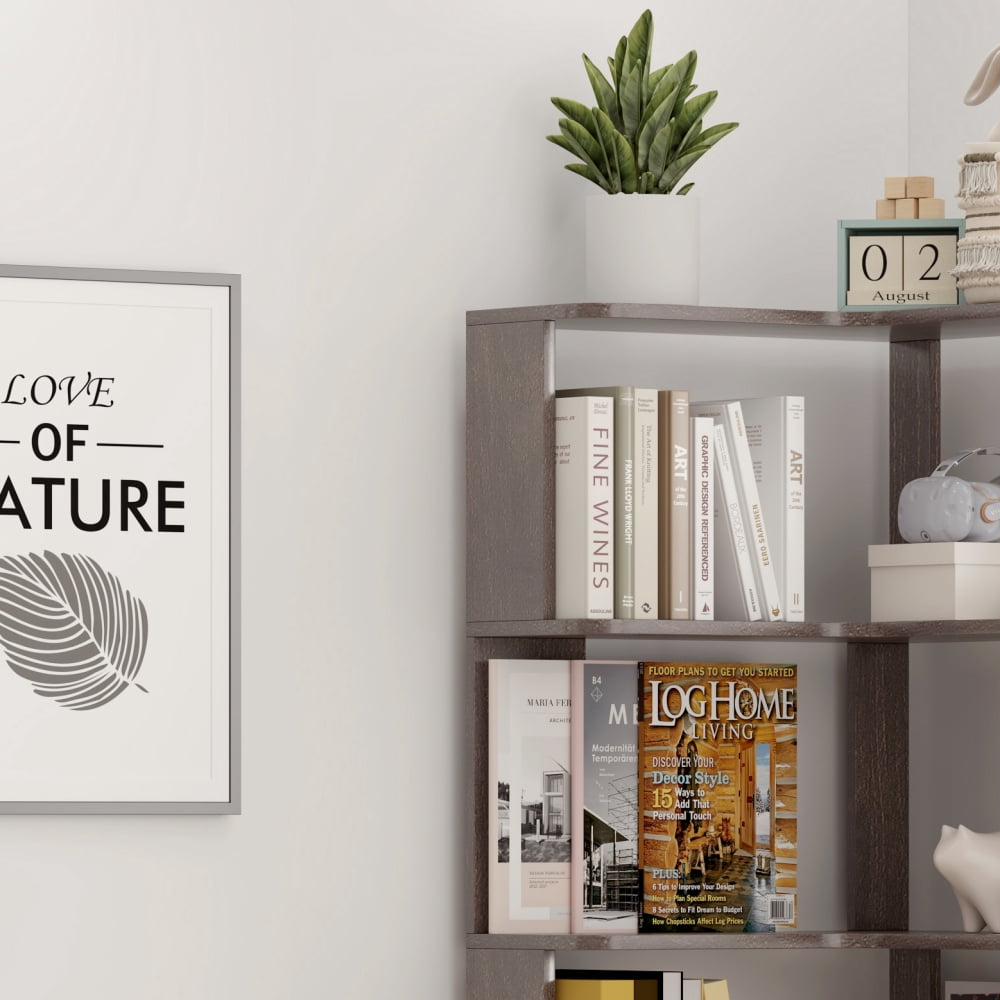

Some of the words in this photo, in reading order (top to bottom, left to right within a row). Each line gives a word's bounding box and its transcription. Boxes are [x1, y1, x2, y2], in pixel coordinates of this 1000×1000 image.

[872, 291, 930, 304] August
[1, 371, 115, 408] LOVE
[31, 422, 89, 462] OF
[593, 428, 609, 486] FINE
[674, 444, 687, 481] ART
[701, 435, 709, 478] GRAPHIC
[624, 460, 632, 486] FRANK
[790, 450, 803, 485] ART
[624, 487, 632, 512] LLOYD
[701, 481, 709, 516] DESIGN
[624, 514, 632, 544] WRIGHT
[751, 503, 765, 544] SAARINEN
[593, 500, 609, 589] WINES
[701, 518, 709, 582] REFERENCED
[760, 546, 770, 567] EERO
[649, 666, 676, 676] FLOOR
[678, 667, 705, 676] PLANS
[708, 667, 718, 677] TO
[720, 667, 736, 677] GET
[739, 668, 755, 677] YOU
[758, 668, 794, 677] STARTED
[527, 698, 554, 707] MARIA
[692, 723, 754, 740] LIVING
[591, 744, 635, 753] Modernität
[652, 756, 691, 768] DISCOVER
[694, 756, 714, 768] YOUR
[652, 771, 692, 785] Decor
[694, 770, 730, 788] Style
[652, 788, 673, 809] 15
[675, 788, 695, 798] Ways
[697, 788, 705, 797] to
[675, 799, 690, 809] Add
[693, 799, 710, 809] That
[652, 810, 687, 820] Personal
[689, 810, 712, 820] Touch
[652, 869, 682, 879] PLUS:
[678, 883, 701, 891] Improve
